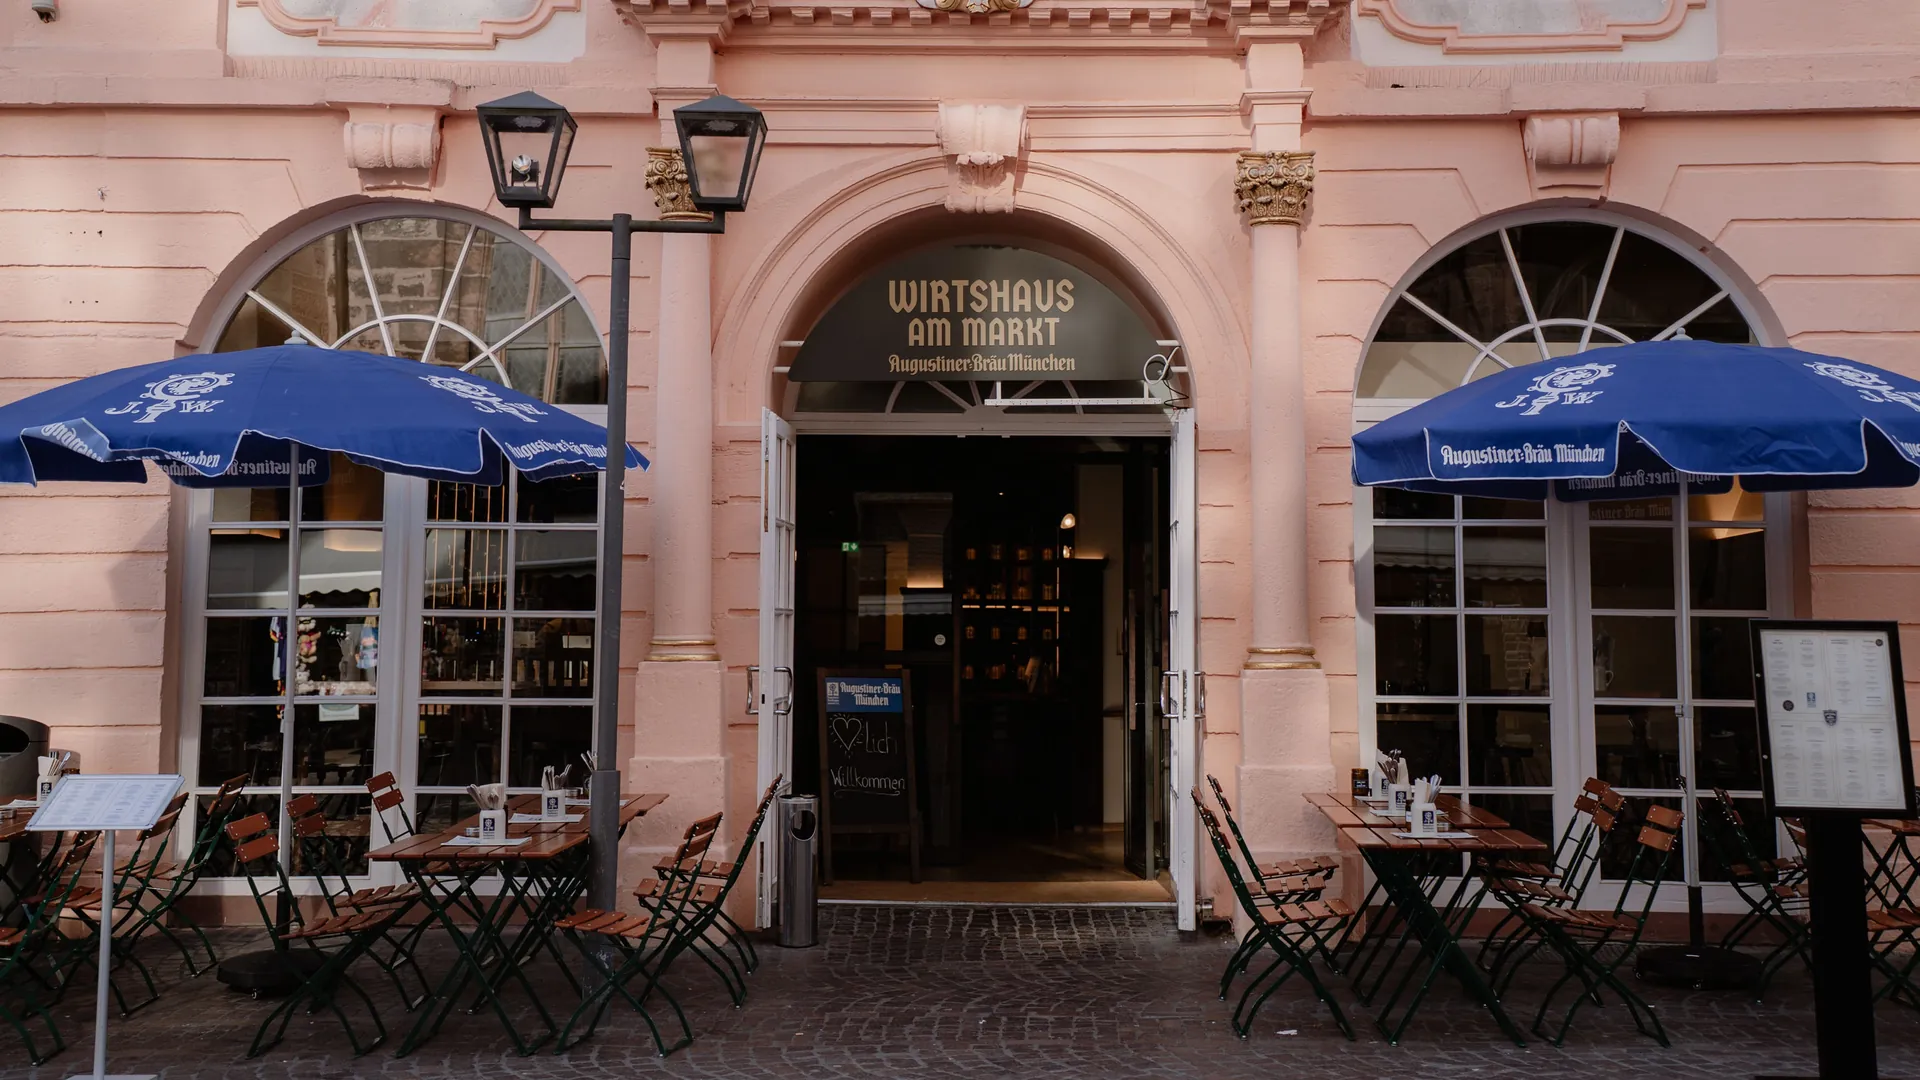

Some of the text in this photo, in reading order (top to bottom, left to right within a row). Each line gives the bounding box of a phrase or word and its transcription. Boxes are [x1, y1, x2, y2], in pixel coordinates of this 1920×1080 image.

[888, 278, 1075, 313] WIRTSHAUS
[908, 317, 1060, 346] AM MARKT
[1007, 353, 1076, 372] München
[1553, 443, 1605, 462] München
[854, 694, 889, 706] München
[831, 766, 905, 790] Willkommen
